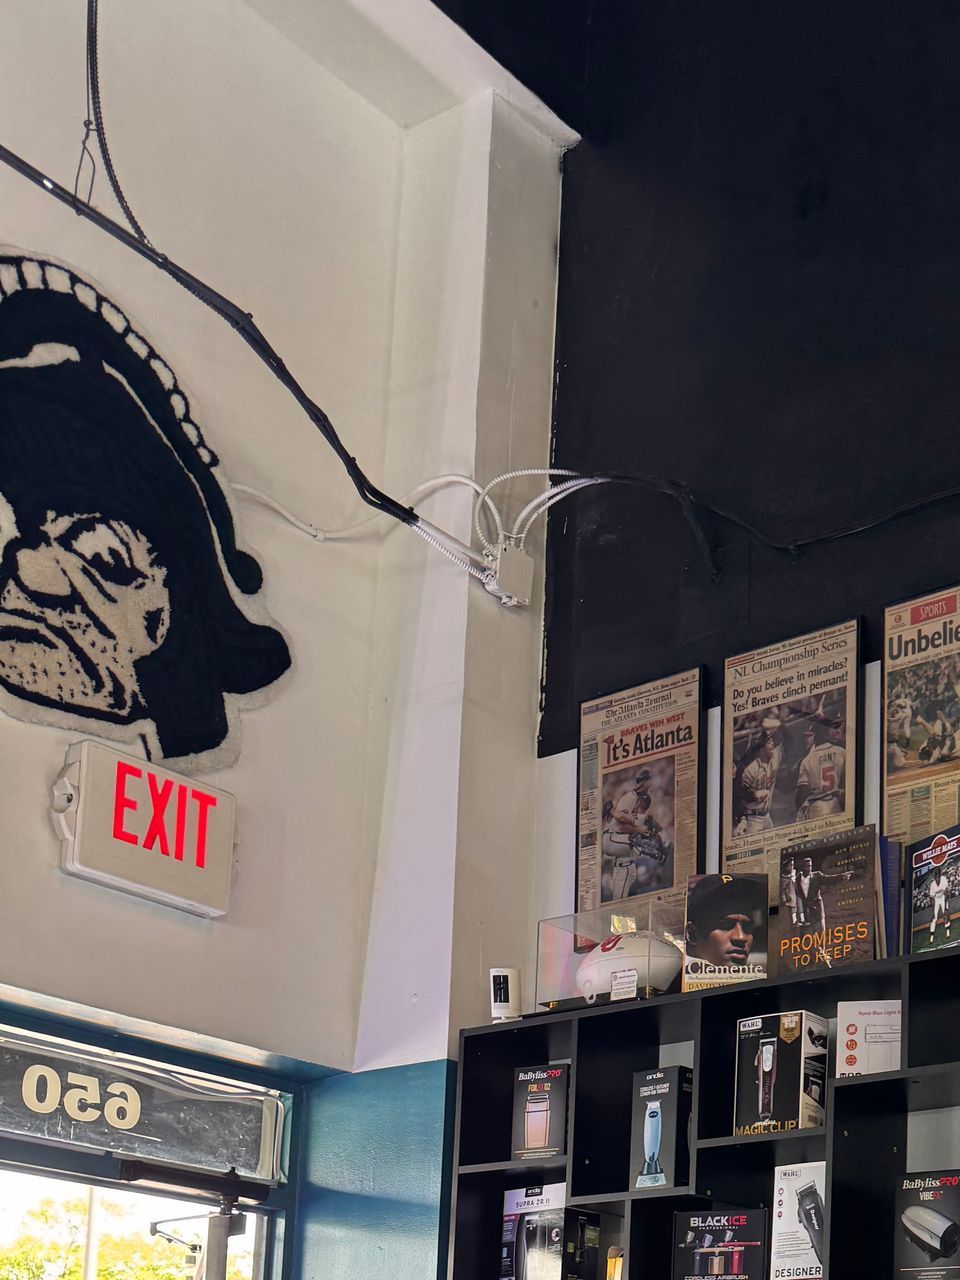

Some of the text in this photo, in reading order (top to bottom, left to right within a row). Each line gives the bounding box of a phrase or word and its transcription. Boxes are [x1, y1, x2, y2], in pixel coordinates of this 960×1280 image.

[920, 601, 947, 620] SPORTS
[733, 667, 750, 680] NL
[752, 646, 820, 674] Championship
[821, 638, 848, 653] Series
[733, 657, 848, 700] Do you believe in miracles?
[732, 671, 849, 713] Yes! Braves clinch pennant!
[605, 709, 618, 719] The
[618, 701, 644, 716] Atlanta
[645, 692, 672, 706] Journal
[620, 712, 686, 737] BRAVES WIN WEST
[632, 724, 694, 756] Atlanta
[821, 766, 836, 792] 5
[112, 760, 217, 869] EXIT
[922, 846, 942, 861] WILLIE
[779, 921, 869, 957] PROMISES
[687, 961, 763, 975] Clemente
[793, 945, 852, 968] TO KEEP
[742, 1020, 761, 1031] WAHL
[735, 1120, 797, 1137] MAGIC CLIP
[782, 1170, 799, 1178] WAHL
[516, 1199, 534, 1208] SUPRA
[536, 1198, 544, 1206] ZR
[775, 1267, 822, 1278] DESIGNER
